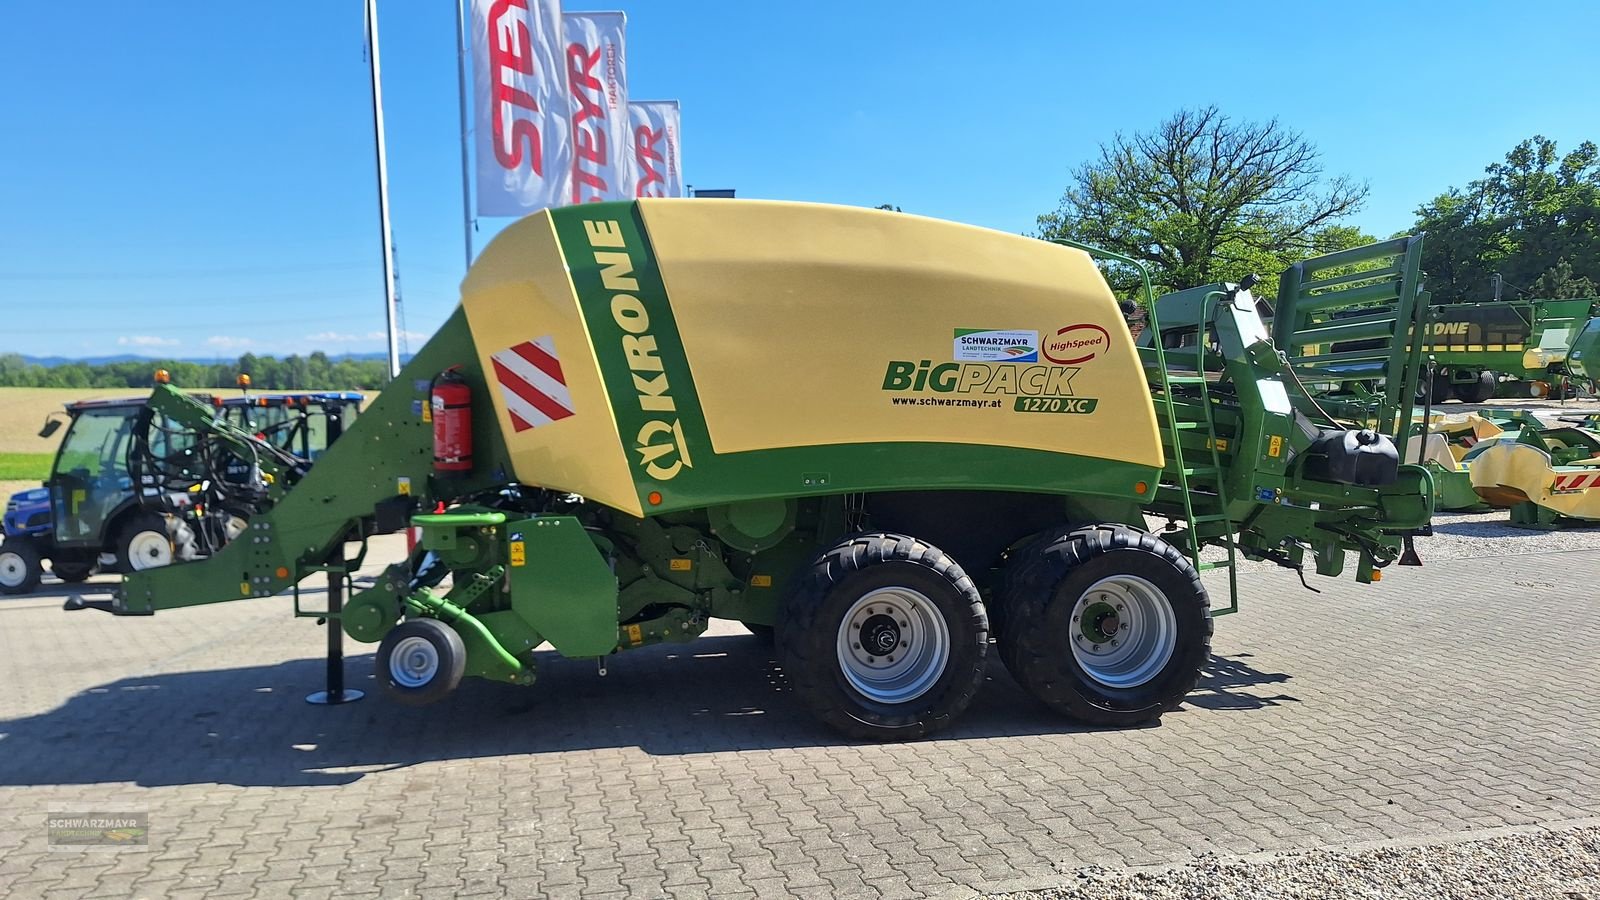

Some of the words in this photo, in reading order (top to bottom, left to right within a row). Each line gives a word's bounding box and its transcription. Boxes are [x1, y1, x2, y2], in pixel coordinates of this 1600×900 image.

[608, 43, 617, 110] TRAKTOREN
[583, 220, 677, 412] KRONE
[961, 336, 1028, 346] SCHWARZMAYR
[1049, 337, 1103, 351] HighSpeed
[892, 397, 1002, 408] www.schwarzmayr.at
[1023, 398, 1061, 412] 1270
[1064, 399, 1088, 412] XC
